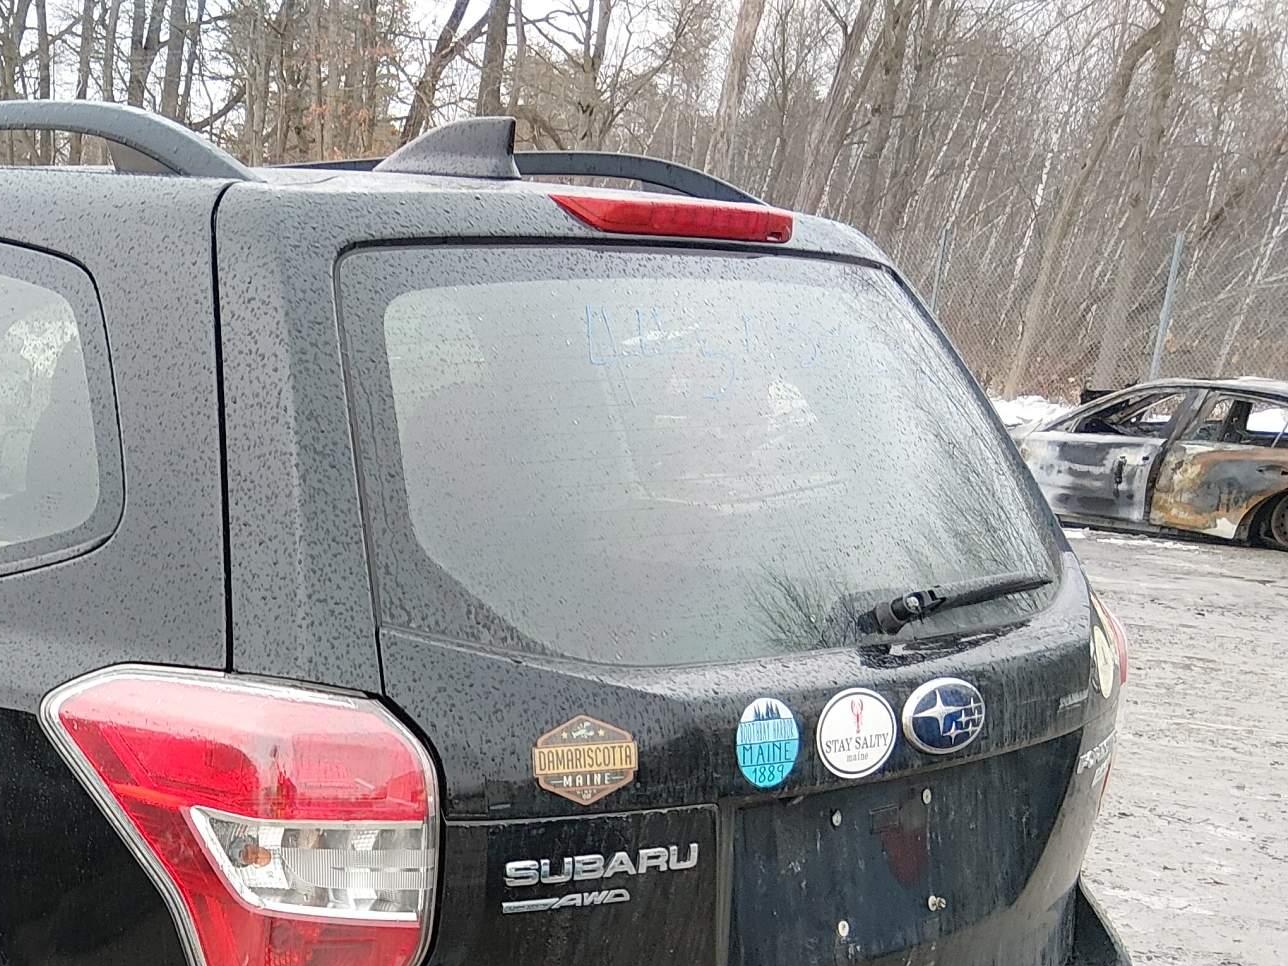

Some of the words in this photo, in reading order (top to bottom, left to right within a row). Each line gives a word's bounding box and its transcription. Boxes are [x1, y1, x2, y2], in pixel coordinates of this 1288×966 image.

[742, 742, 792, 765] MAINE
[825, 737, 854, 754] STAY
[855, 733, 889, 750] SALTY
[538, 744, 632, 772] DAMARISCOTTA
[846, 751, 869, 763] maine
[563, 773, 611, 788] MAINE
[752, 764, 784, 784] 1889
[504, 843, 699, 887] SUBARU
[551, 889, 630, 910] AWD
